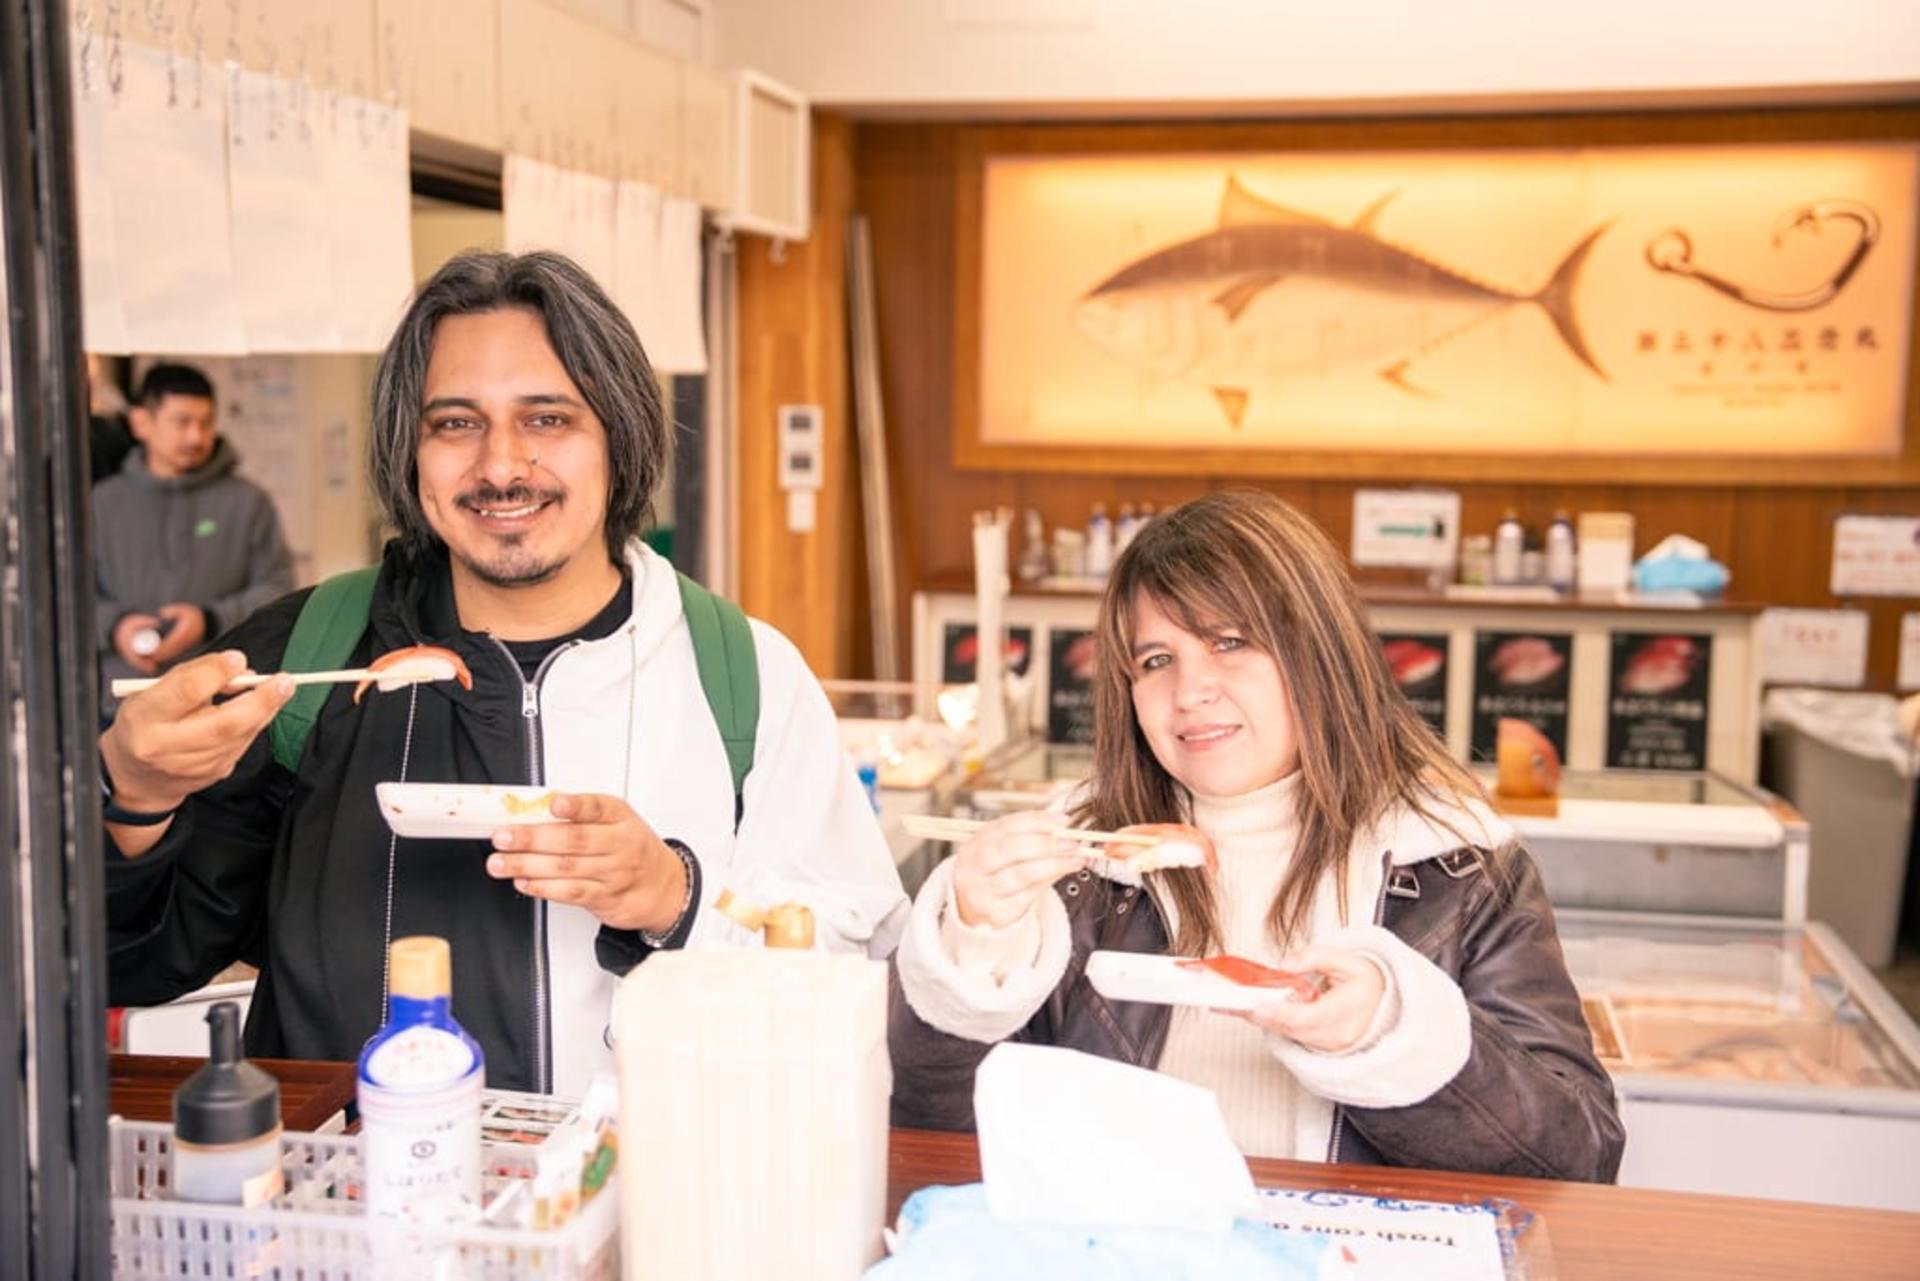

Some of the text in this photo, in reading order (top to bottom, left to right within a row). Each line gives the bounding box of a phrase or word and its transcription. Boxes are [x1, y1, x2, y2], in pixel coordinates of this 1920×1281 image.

[1266, 1222, 1457, 1247] Trash cans a
